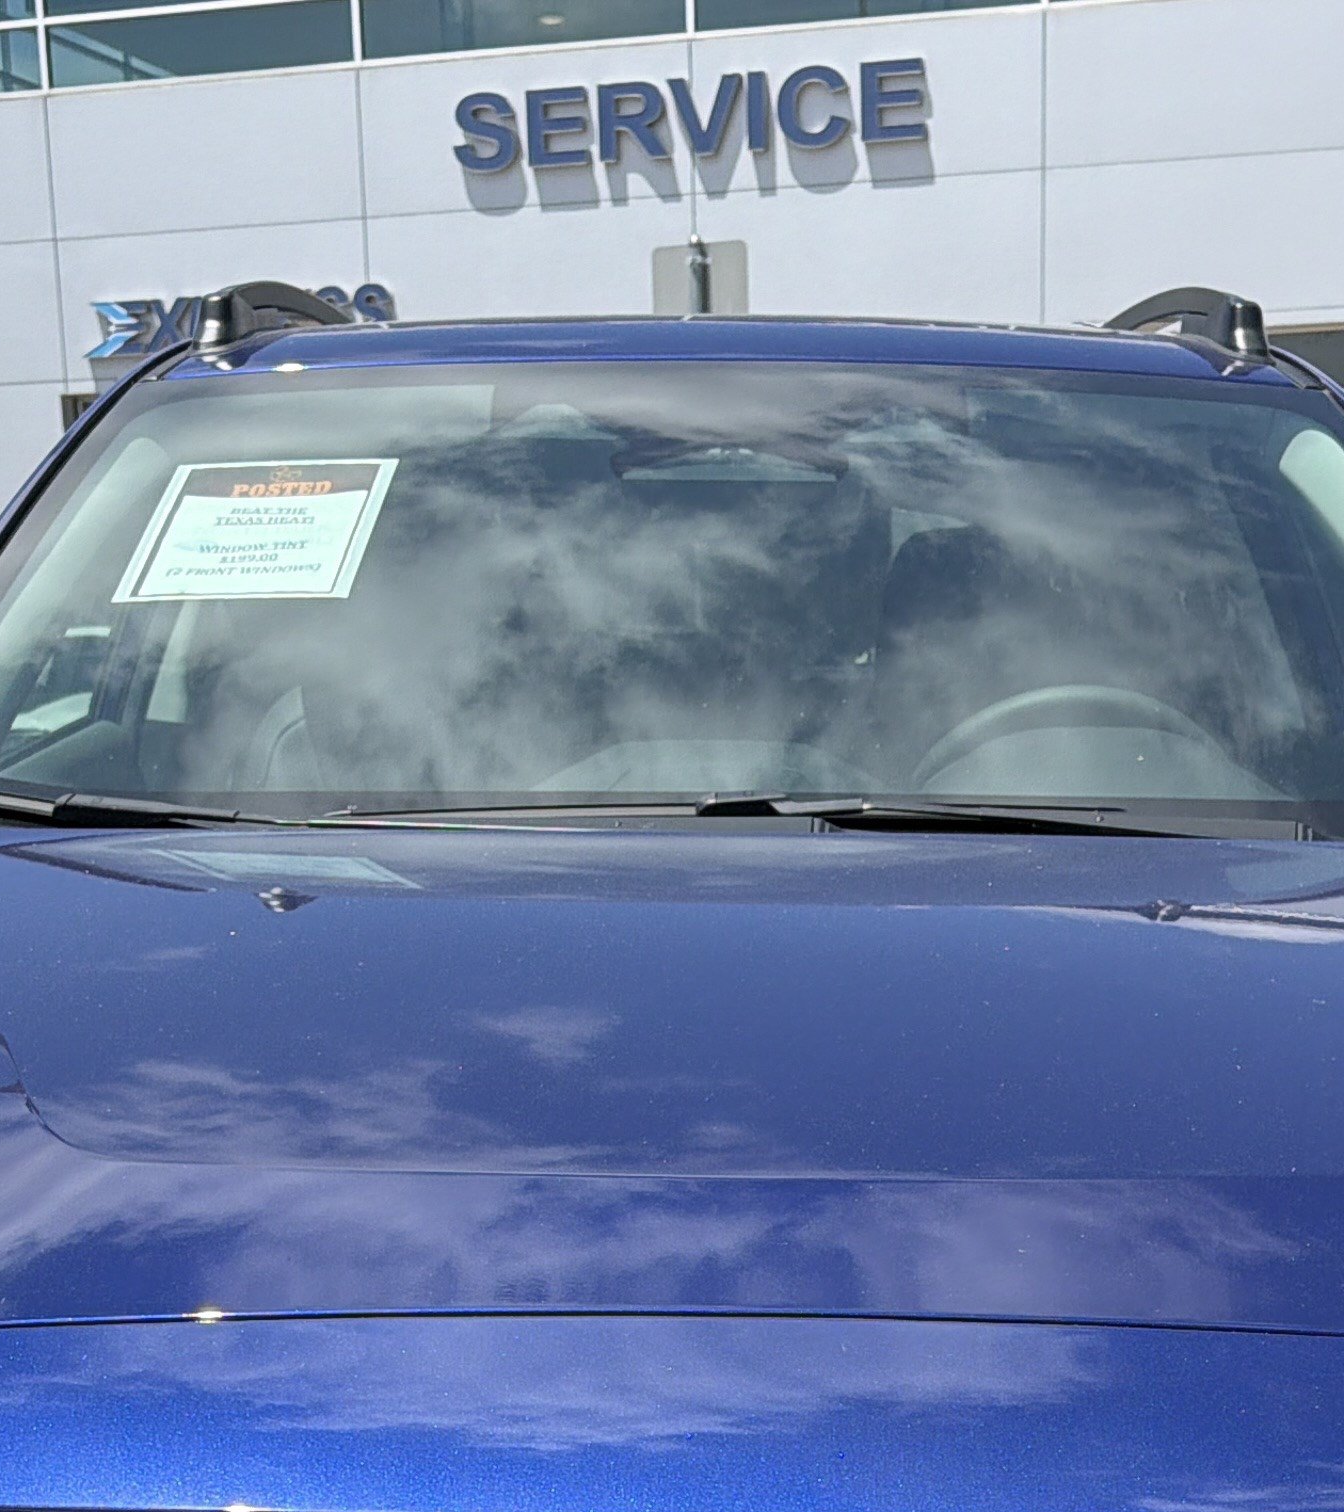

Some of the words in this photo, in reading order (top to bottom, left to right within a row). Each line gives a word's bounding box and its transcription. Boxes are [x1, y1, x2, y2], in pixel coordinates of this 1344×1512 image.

[453, 57, 929, 173] SERVICE
[230, 480, 333, 498] POSTED
[230, 507, 270, 515] BEAT
[274, 507, 309, 515] THE
[214, 516, 265, 527] TEXAS
[198, 542, 269, 554] WINDOW
[273, 539, 309, 551] TINT
[219, 552, 280, 565] $199.00
[185, 566, 237, 577] FRONT
